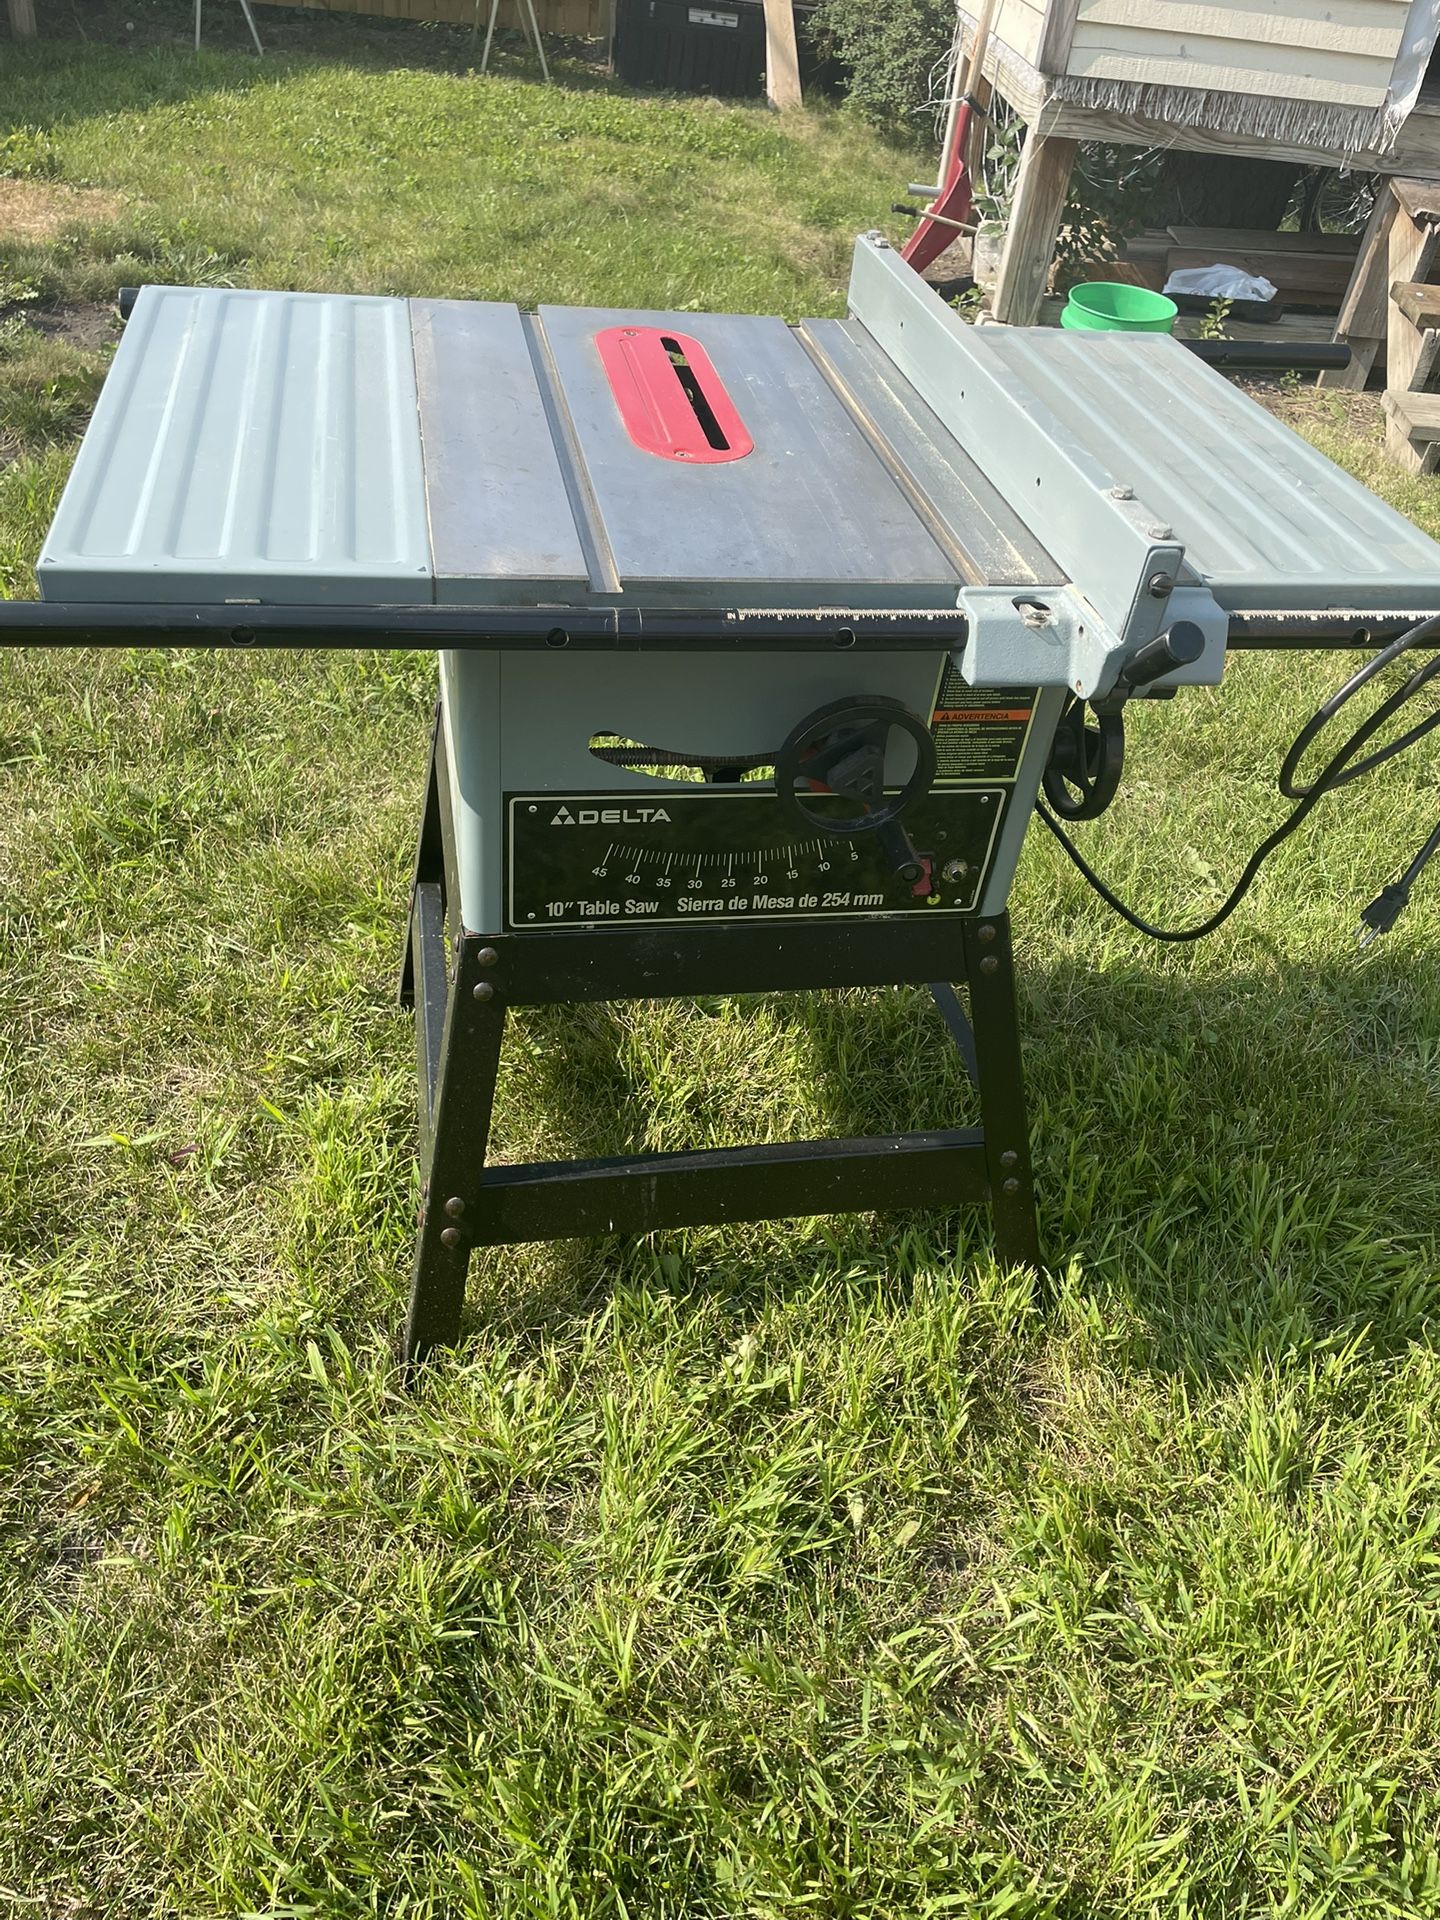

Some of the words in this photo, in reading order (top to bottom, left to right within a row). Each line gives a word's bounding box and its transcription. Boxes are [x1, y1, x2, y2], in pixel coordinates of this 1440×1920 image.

[951, 713, 1009, 721] ADVERTENCIA
[578, 808, 672, 825] DELTA
[592, 867, 608, 877] 45
[625, 874, 641, 884] 40
[656, 878, 671, 888] 35
[687, 880, 703, 889] 30
[721, 878, 736, 888] 25
[753, 875, 768, 885] 20
[786, 869, 799, 880] 15
[818, 861, 831, 872] 10
[851, 851, 859, 861] 5
[545, 901, 574, 917] 10"
[577, 900, 620, 916] Table
[624, 899, 659, 914] Saw
[677, 897, 724, 912] Sierra
[728, 896, 748, 910] de
[752, 895, 795, 909] Mesa
[798, 893, 818, 908] de
[821, 892, 851, 907] 254
[853, 893, 884, 906] mm
